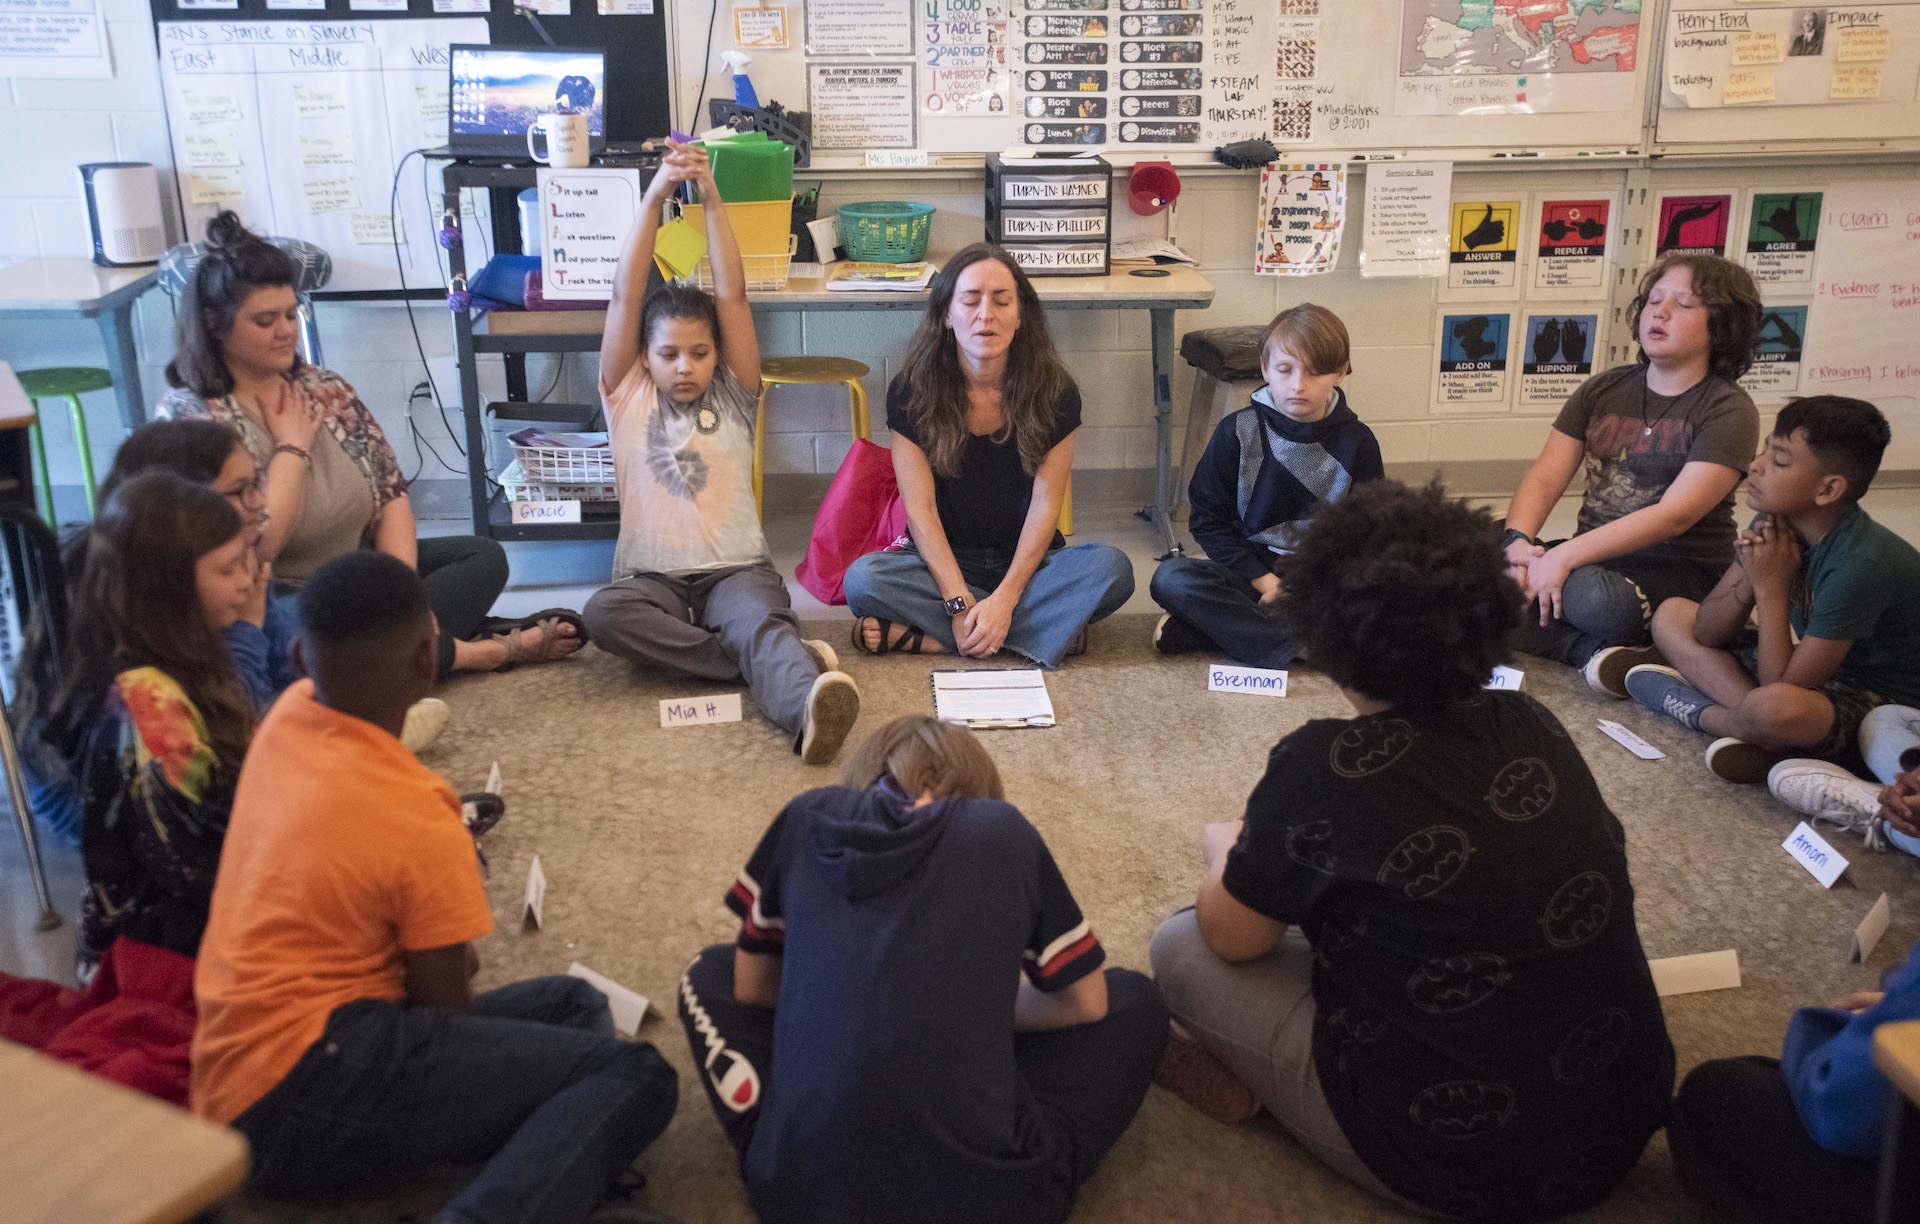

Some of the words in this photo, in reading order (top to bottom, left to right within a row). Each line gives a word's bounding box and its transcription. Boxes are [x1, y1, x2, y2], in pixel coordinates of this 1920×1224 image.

[1143, 0, 1167, 9] Block
[926, 0, 940, 21] 4
[946, 0, 982, 11] LOUD
[947, 11, 979, 20] CROWD
[1047, 17, 1083, 26] Morning
[1224, 14, 1254, 25] Library
[1678, 13, 1717, 31] Henry
[1719, 11, 1750, 29] Ford
[1828, 11, 1884, 29] Impact
[221, 24, 275, 41] Stance
[286, 26, 305, 39] on
[310, 24, 376, 43] Slavery
[926, 24, 940, 44] 3
[945, 23, 982, 34] TABLE
[1047, 26, 1082, 36] Meeting
[1142, 26, 1164, 35] Time
[951, 34, 975, 44] talk
[1143, 43, 1166, 52] Block
[1226, 40, 1242, 49] Art
[170, 48, 217, 71] East
[289, 47, 350, 67] Middle
[926, 47, 940, 66] 2
[940, 47, 986, 57] PARTNER
[1149, 53, 1161, 61] #3
[1226, 53, 1241, 66] PE
[932, 68, 937, 91] 1
[940, 70, 986, 80] WHISPER
[1050, 72, 1073, 80] Block
[1142, 71, 1159, 79] Pack
[1160, 72, 1168, 80] up
[1169, 71, 1175, 79] &
[947, 81, 981, 90] voices
[1056, 81, 1066, 89] #1
[1080, 82, 1099, 91] MATH
[1225, 90, 1245, 102] Lab
[926, 93, 943, 112] 0
[1047, 98, 1070, 106] Block
[1054, 108, 1065, 116] #2
[1207, 104, 1267, 123] THURSDAY!
[1329, 116, 1340, 131] @
[1047, 129, 1073, 138] Lunch
[1141, 128, 1177, 136] Dismissal
[889, 152, 926, 167] Haynes
[1386, 169, 1414, 177] Seminar
[1416, 169, 1434, 177] Rules
[572, 190, 584, 198] up
[1011, 184, 1058, 197] TURN-IN:
[1061, 184, 1100, 196] HAYNES
[1296, 192, 1308, 202] The
[1281, 207, 1321, 217] Engineering
[1840, 212, 1888, 227] Claim
[1007, 220, 1053, 232] TURN-IN:
[1057, 219, 1102, 231] PHILLIPS
[1289, 220, 1310, 231] Design
[577, 234, 616, 242] questions
[1554, 247, 1589, 256] REPEAT
[1766, 243, 1797, 251] AGREE
[579, 257, 598, 265] your
[1057, 252, 1101, 265] POWERS
[1465, 252, 1502, 261] ANSWER
[1832, 283, 1880, 296] Evidence
[1754, 353, 1787, 361] LARIFY
[1455, 362, 1477, 371] ADD
[1478, 362, 1491, 370] ON
[1536, 365, 1578, 373] SUPPORT
[1820, 366, 1871, 382] Reasoning
[521, 504, 566, 518] Gracie
[1213, 671, 1283, 690] Brennan
[668, 704, 698, 721] Mia
[1792, 834, 1831, 868] Amoni
